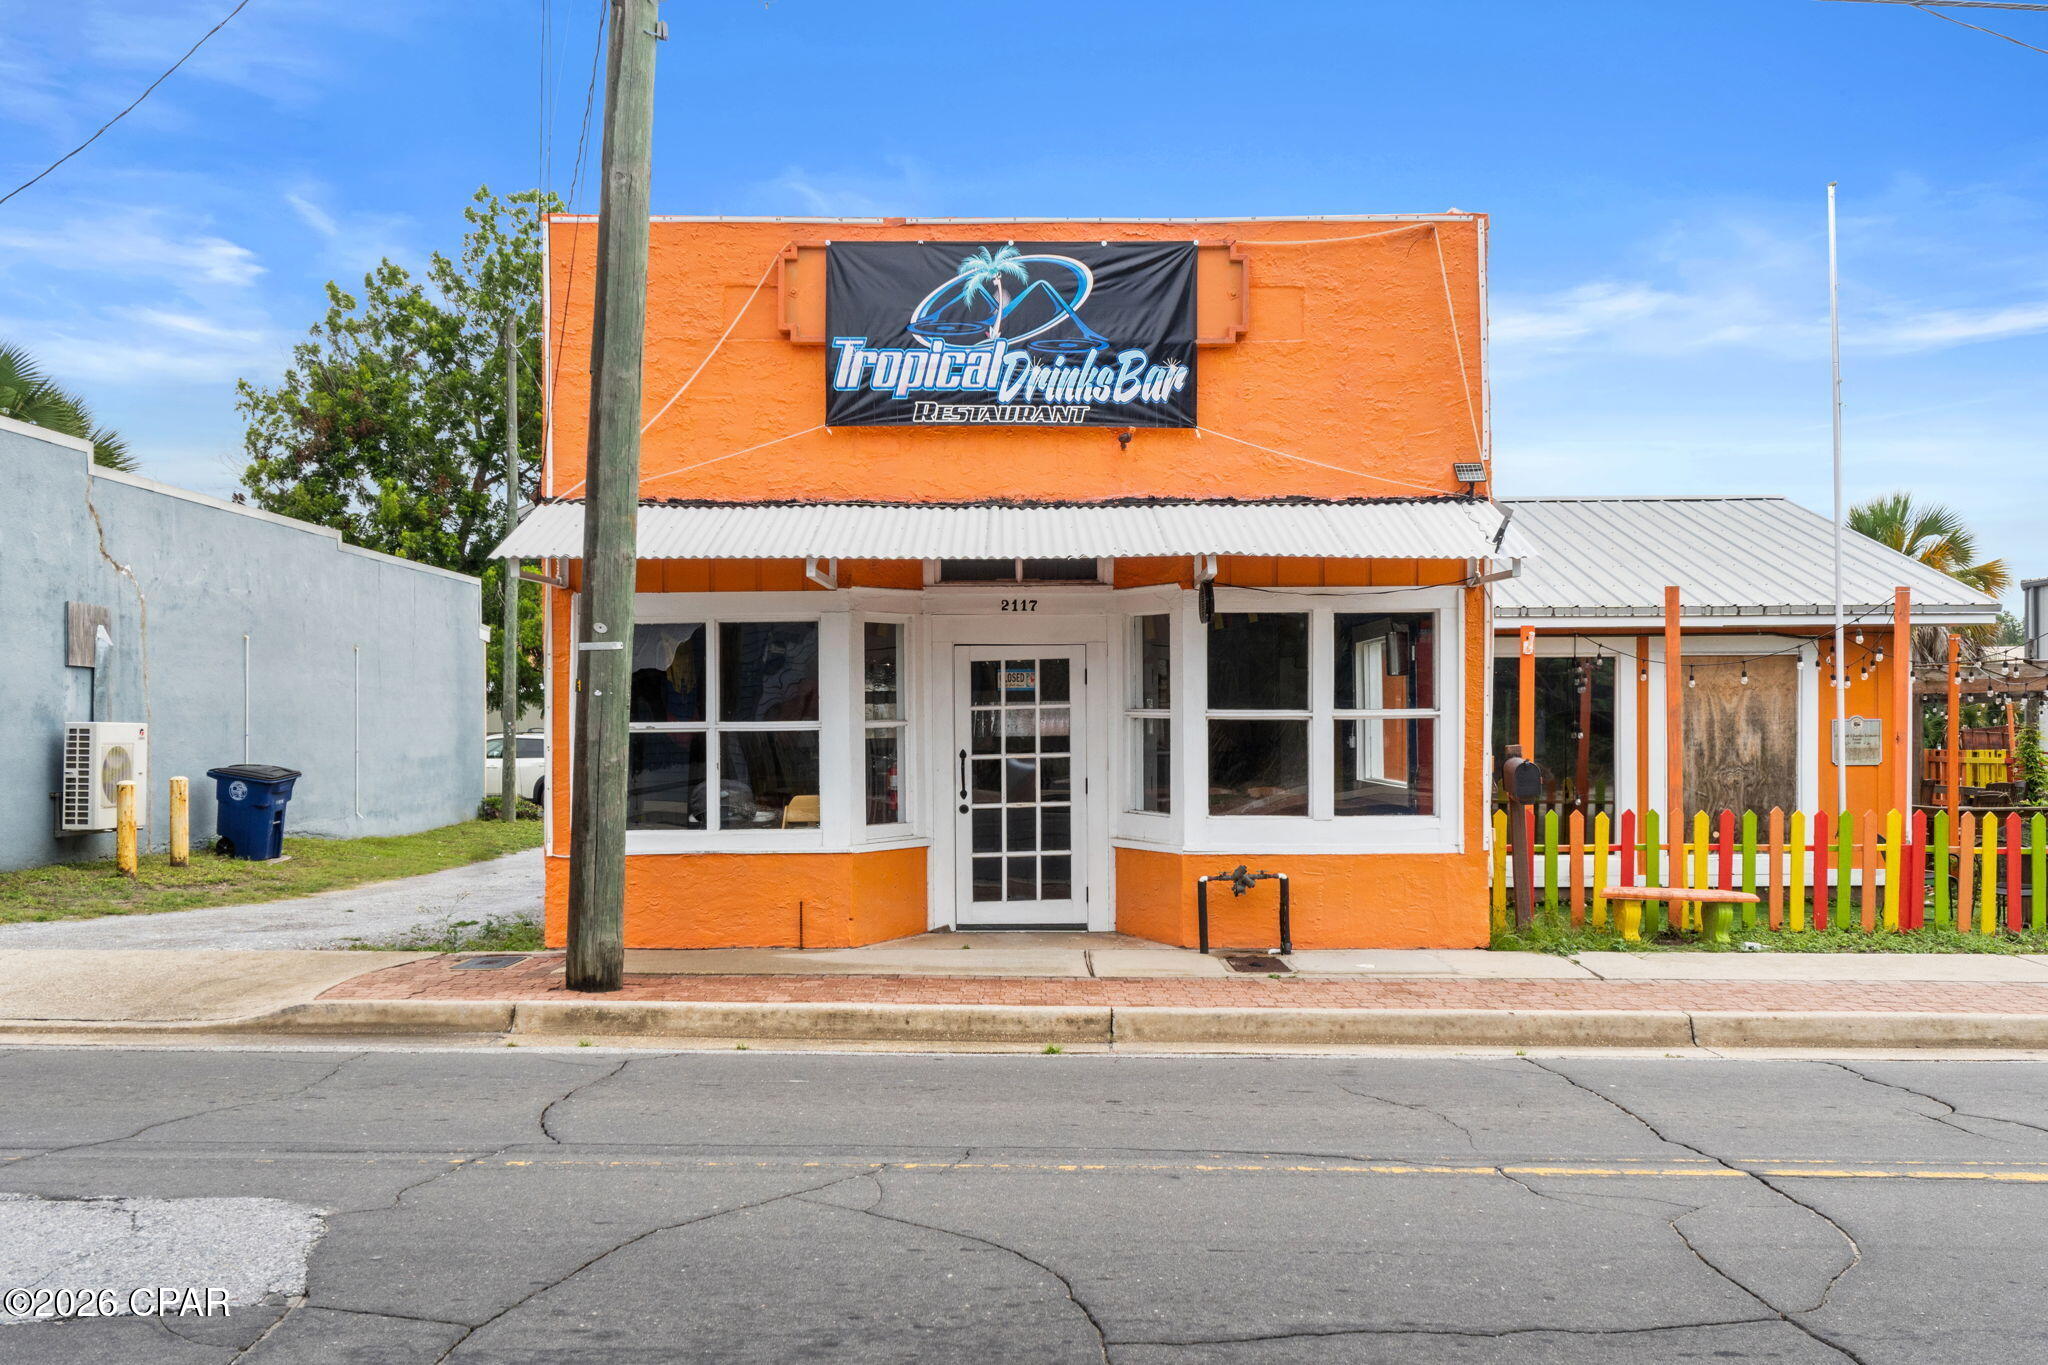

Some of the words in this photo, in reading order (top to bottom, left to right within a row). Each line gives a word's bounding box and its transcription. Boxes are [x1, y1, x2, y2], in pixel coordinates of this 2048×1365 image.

[833, 337, 1008, 400] Tropical
[912, 401, 1091, 424] RESTAURANT
[1001, 599, 1038, 612] 2117
[999, 672, 1025, 683] OSED
